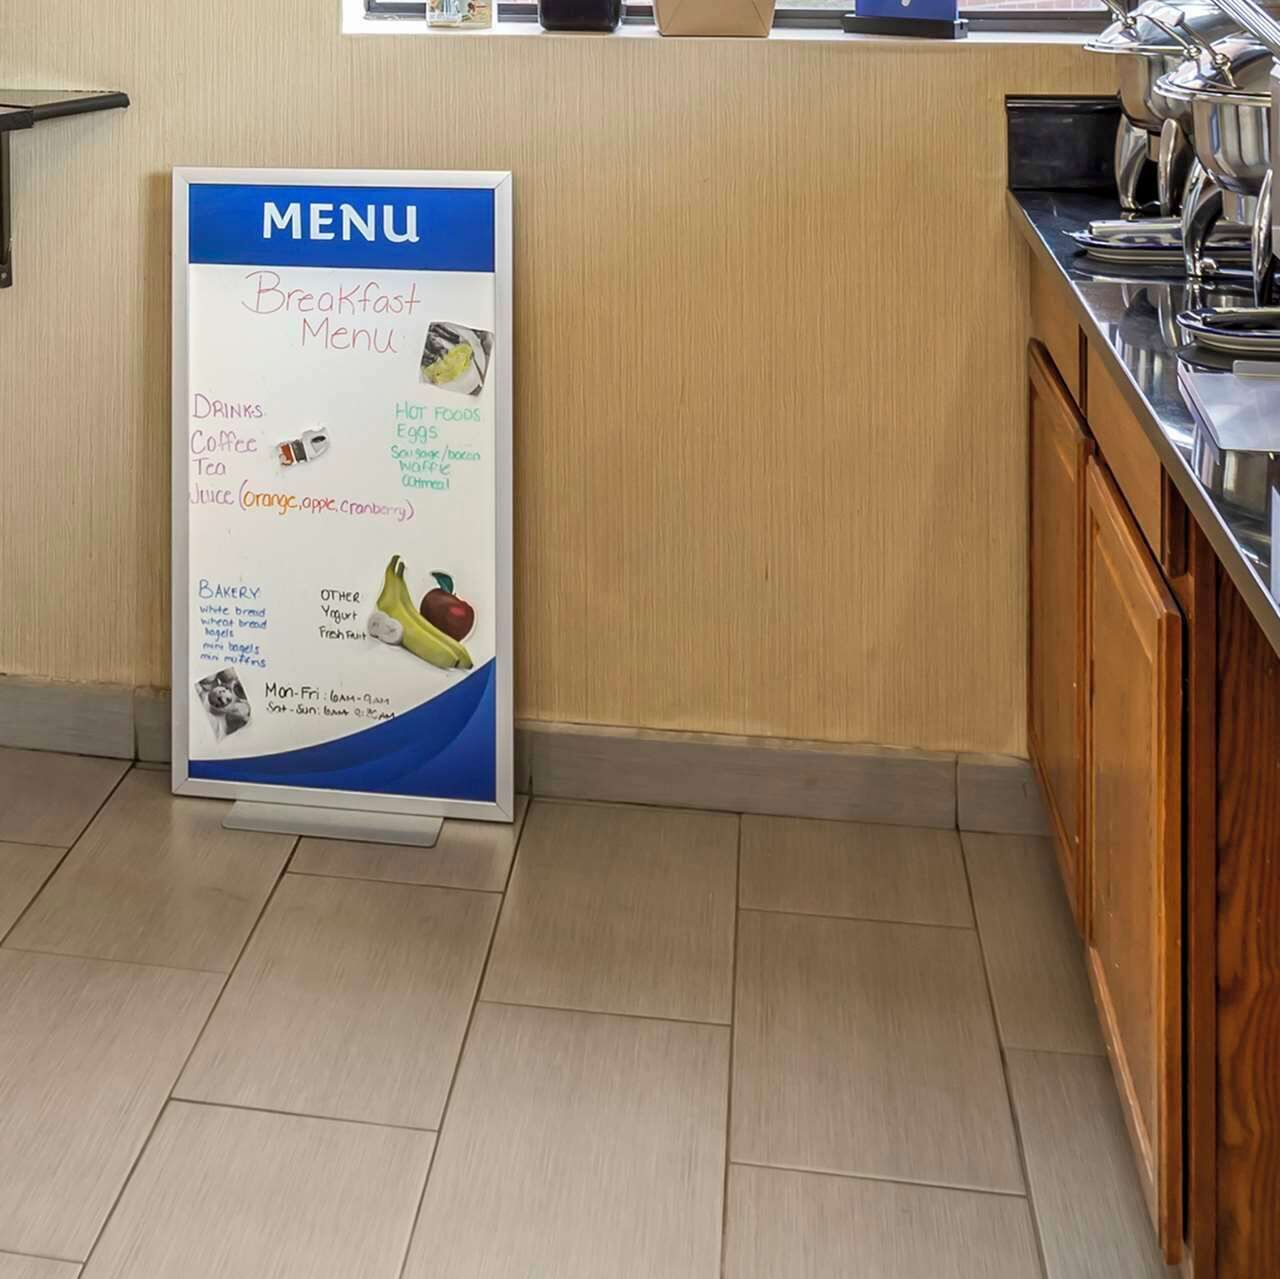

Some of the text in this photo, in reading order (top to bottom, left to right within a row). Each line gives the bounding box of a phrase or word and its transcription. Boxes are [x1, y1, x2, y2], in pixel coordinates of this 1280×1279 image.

[262, 201, 420, 243] MENU
[241, 270, 422, 315] Breakfast
[301, 316, 398, 354] Menu
[192, 392, 264, 419] DRINKS
[395, 400, 481, 422] HOT FOODS
[190, 429, 258, 455] Coffee
[396, 422, 439, 445] Eggs
[192, 457, 227, 476] Tea
[189, 482, 235, 506] Juice
[198, 578, 261, 600] BAKERY
[320, 588, 361, 604] OTHER
[320, 605, 358, 625] Yogurt
